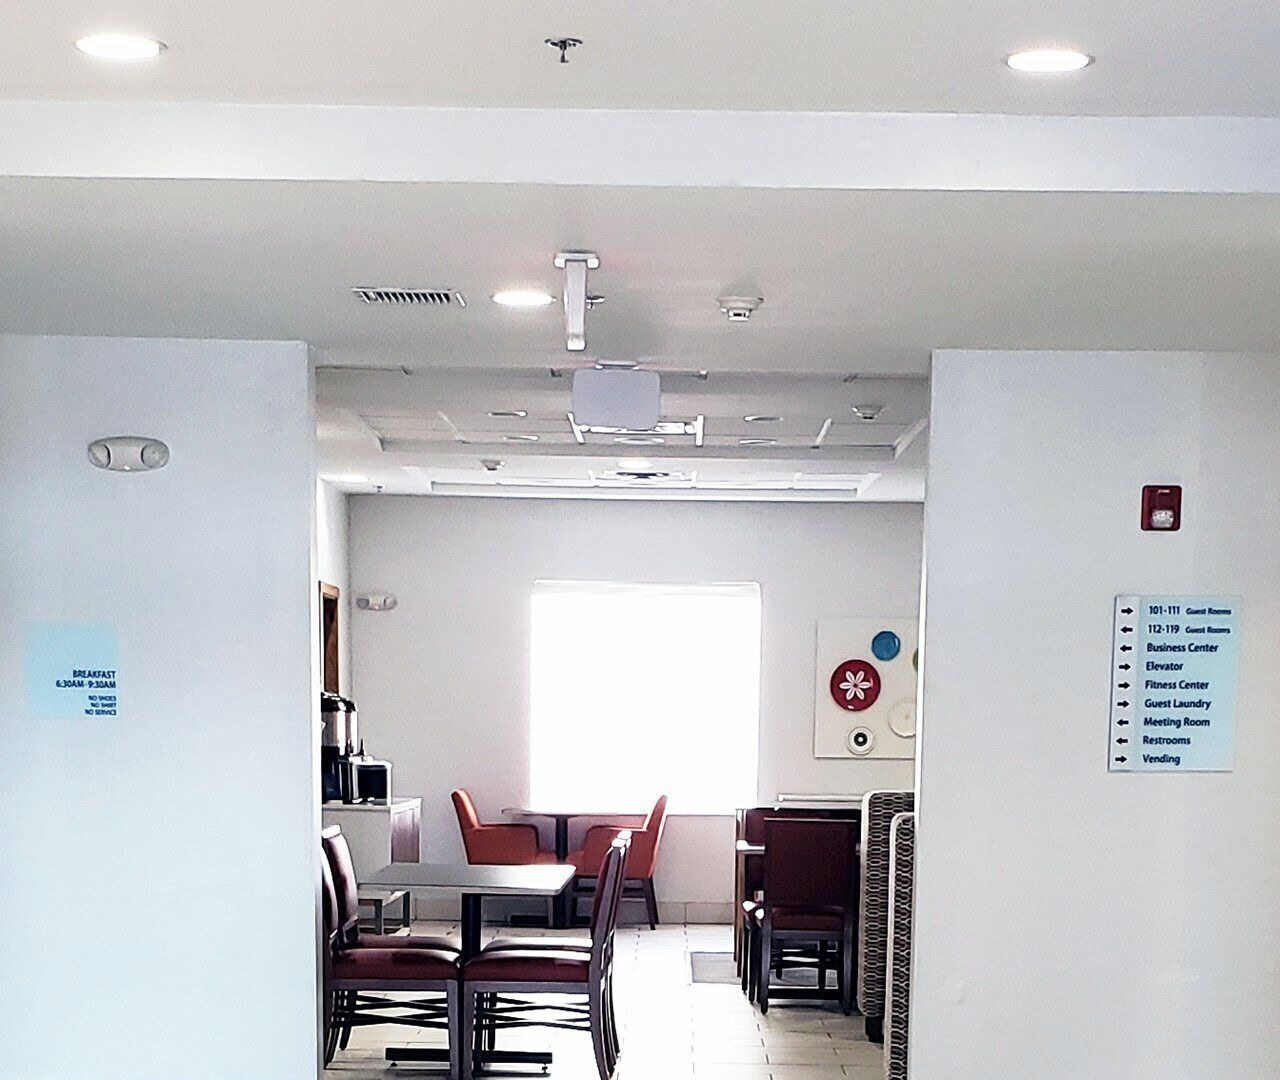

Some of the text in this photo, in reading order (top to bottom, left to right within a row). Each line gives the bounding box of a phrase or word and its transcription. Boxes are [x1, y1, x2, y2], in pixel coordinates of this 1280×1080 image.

[1148, 605, 1180, 615] 101-111
[1148, 624, 1179, 634] 112-119
[1146, 642, 1218, 652] Business Center
[1145, 661, 1183, 671] Elevator
[72, 669, 116, 679] BREAKFAST
[1144, 680, 1209, 689] Fitness Center
[1144, 699, 1211, 710] Guest Laundry
[1143, 717, 1210, 728] Meeting Room
[1142, 736, 1191, 745] Restrooms
[1142, 754, 1181, 765] Vending
